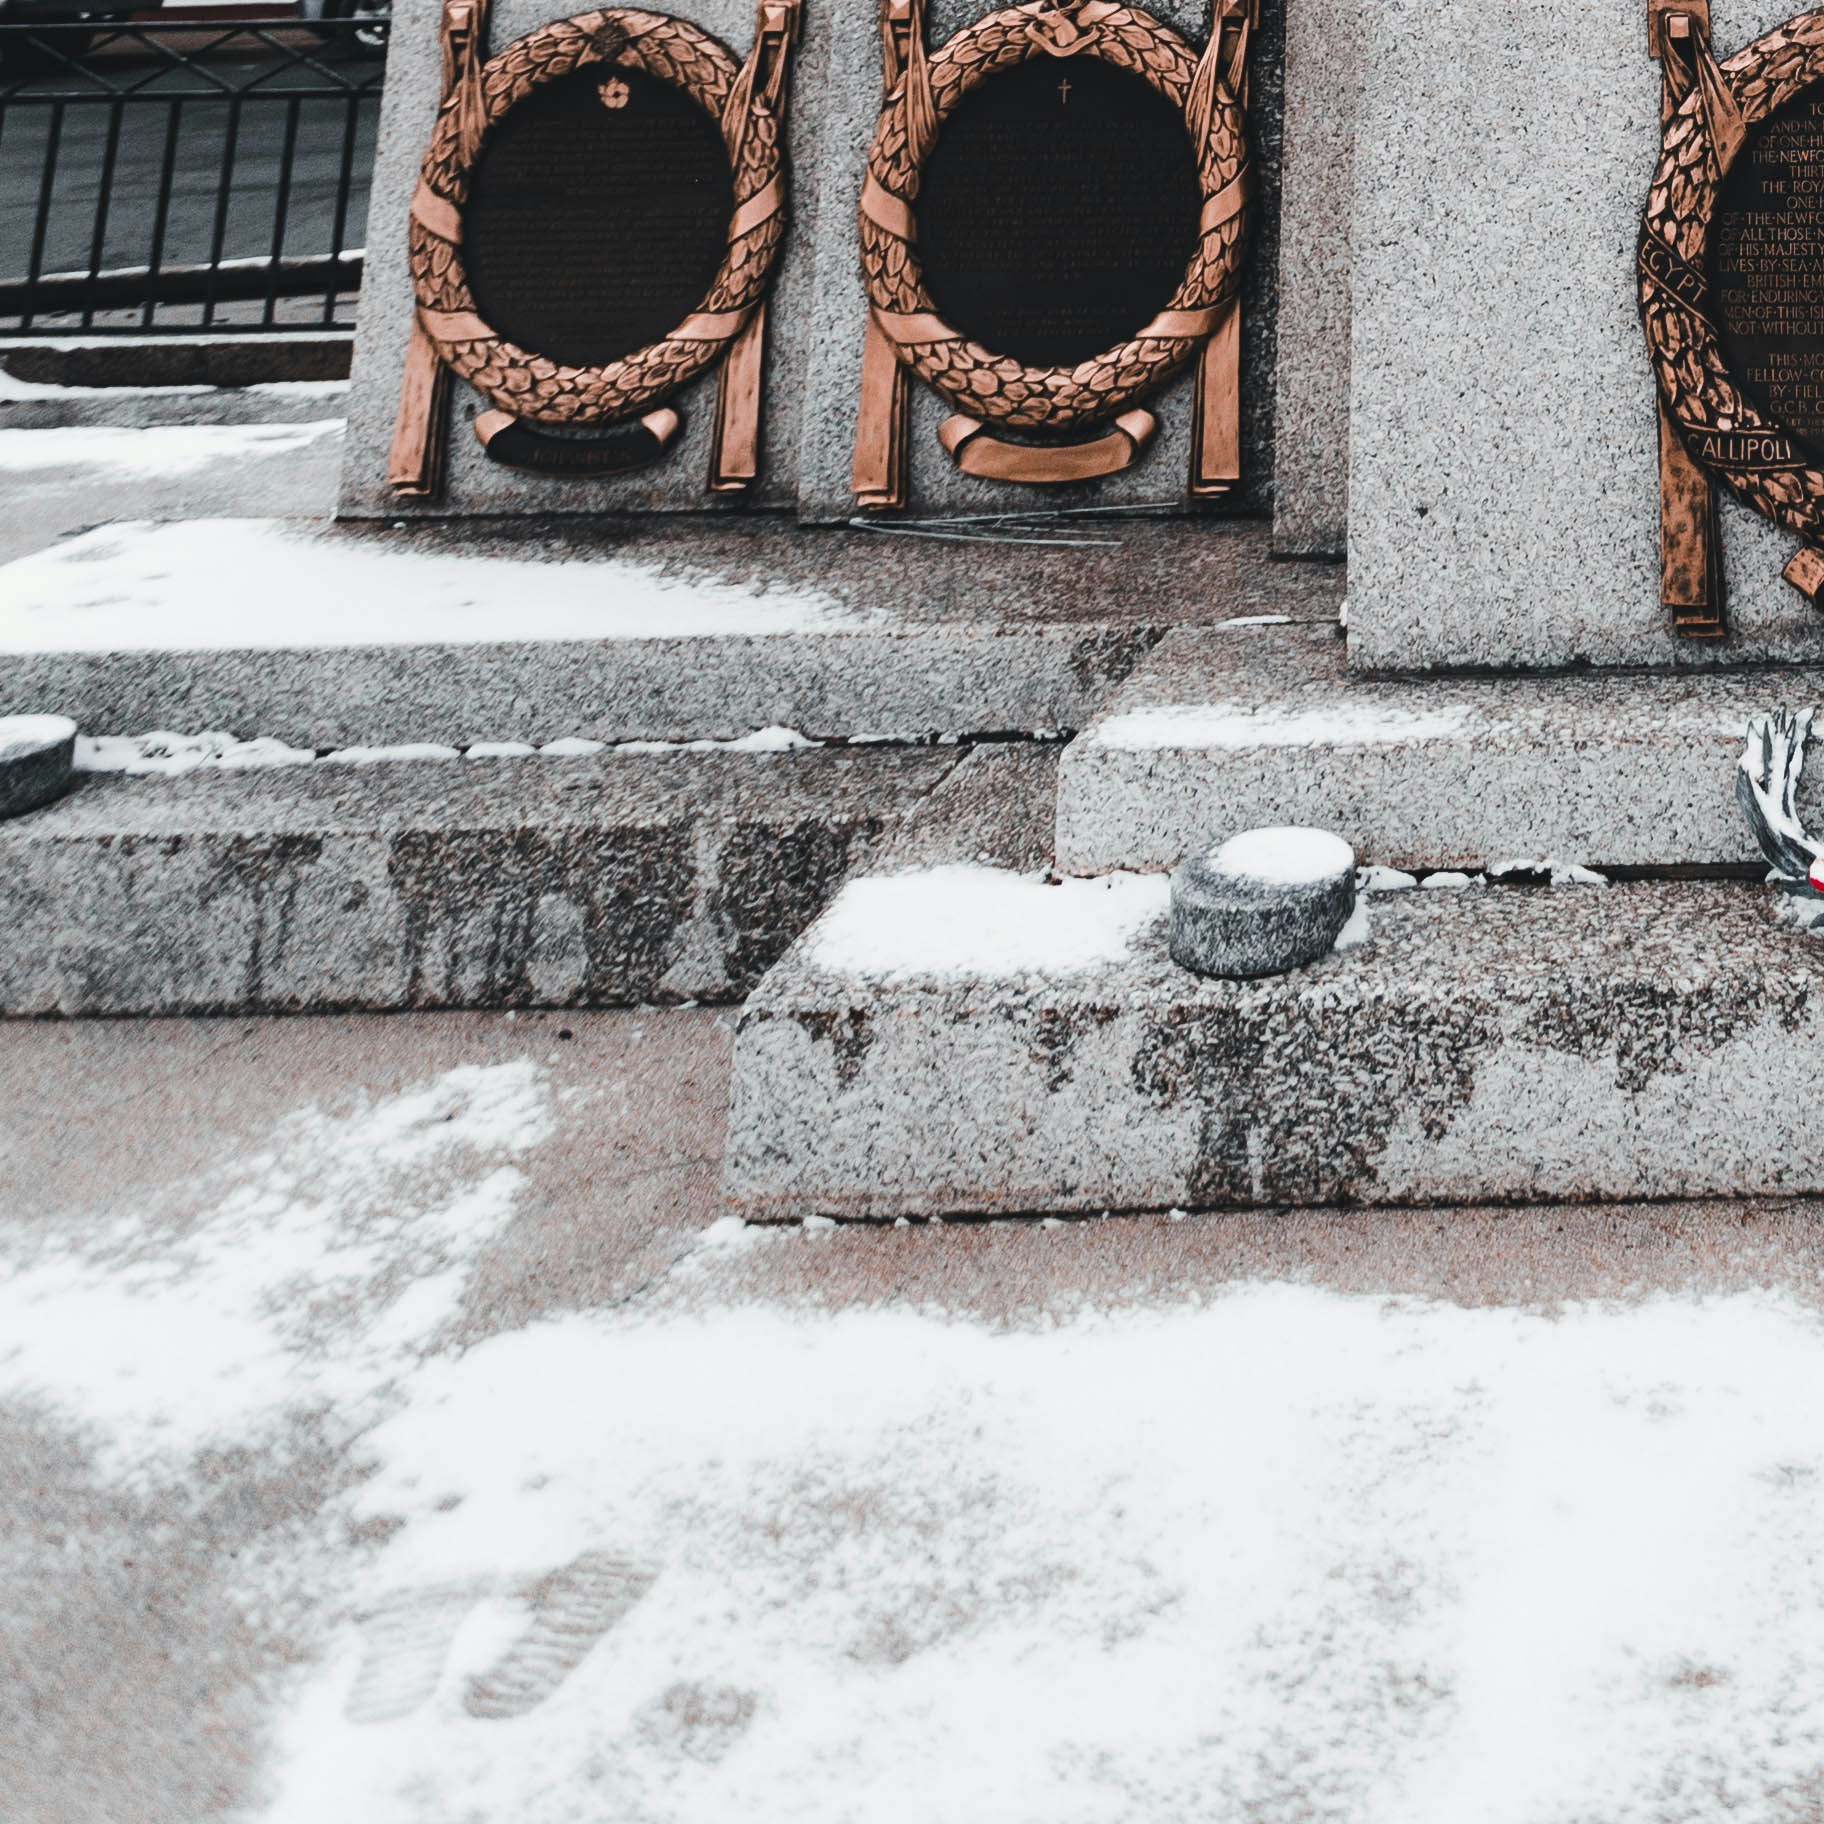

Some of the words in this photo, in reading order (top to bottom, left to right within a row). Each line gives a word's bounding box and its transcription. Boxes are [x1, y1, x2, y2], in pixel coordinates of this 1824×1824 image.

[1770, 118, 1799, 132] AND
[1804, 118, 1816, 132] IN
[1760, 135, 1775, 148] OF
[1780, 134, 1806, 148] ONE
[1752, 150, 1776, 163] THE
[1761, 180, 1787, 194] THE
[1786, 195, 1815, 209] ONE
[1746, 212, 1772, 226] THE
[1740, 228, 1765, 242] ALL
[1769, 227, 1811, 241] THOSE
[1739, 243, 1760, 258] HIS
[1641, 239, 1708, 302] EGYPT
[1720, 259, 1755, 273] LIVES
[1760, 259, 1778, 272] BY
[1782, 258, 1807, 272] SEA
[1747, 274, 1797, 289] BRITISH
[1721, 291, 1746, 305] FOR
[1752, 289, 1818, 304] ENDURING
[1724, 307, 1751, 321] MEN
[1755, 306, 1772, 320] OF
[1776, 306, 1806, 320] THIS
[1730, 322, 1756, 337] NOT
[1761, 321, 1824, 336] WITHOUT
[1769, 353, 1798, 367] THIS
[1770, 385, 1787, 399] BY
[1688, 433, 1791, 461] GALLIPOLI
